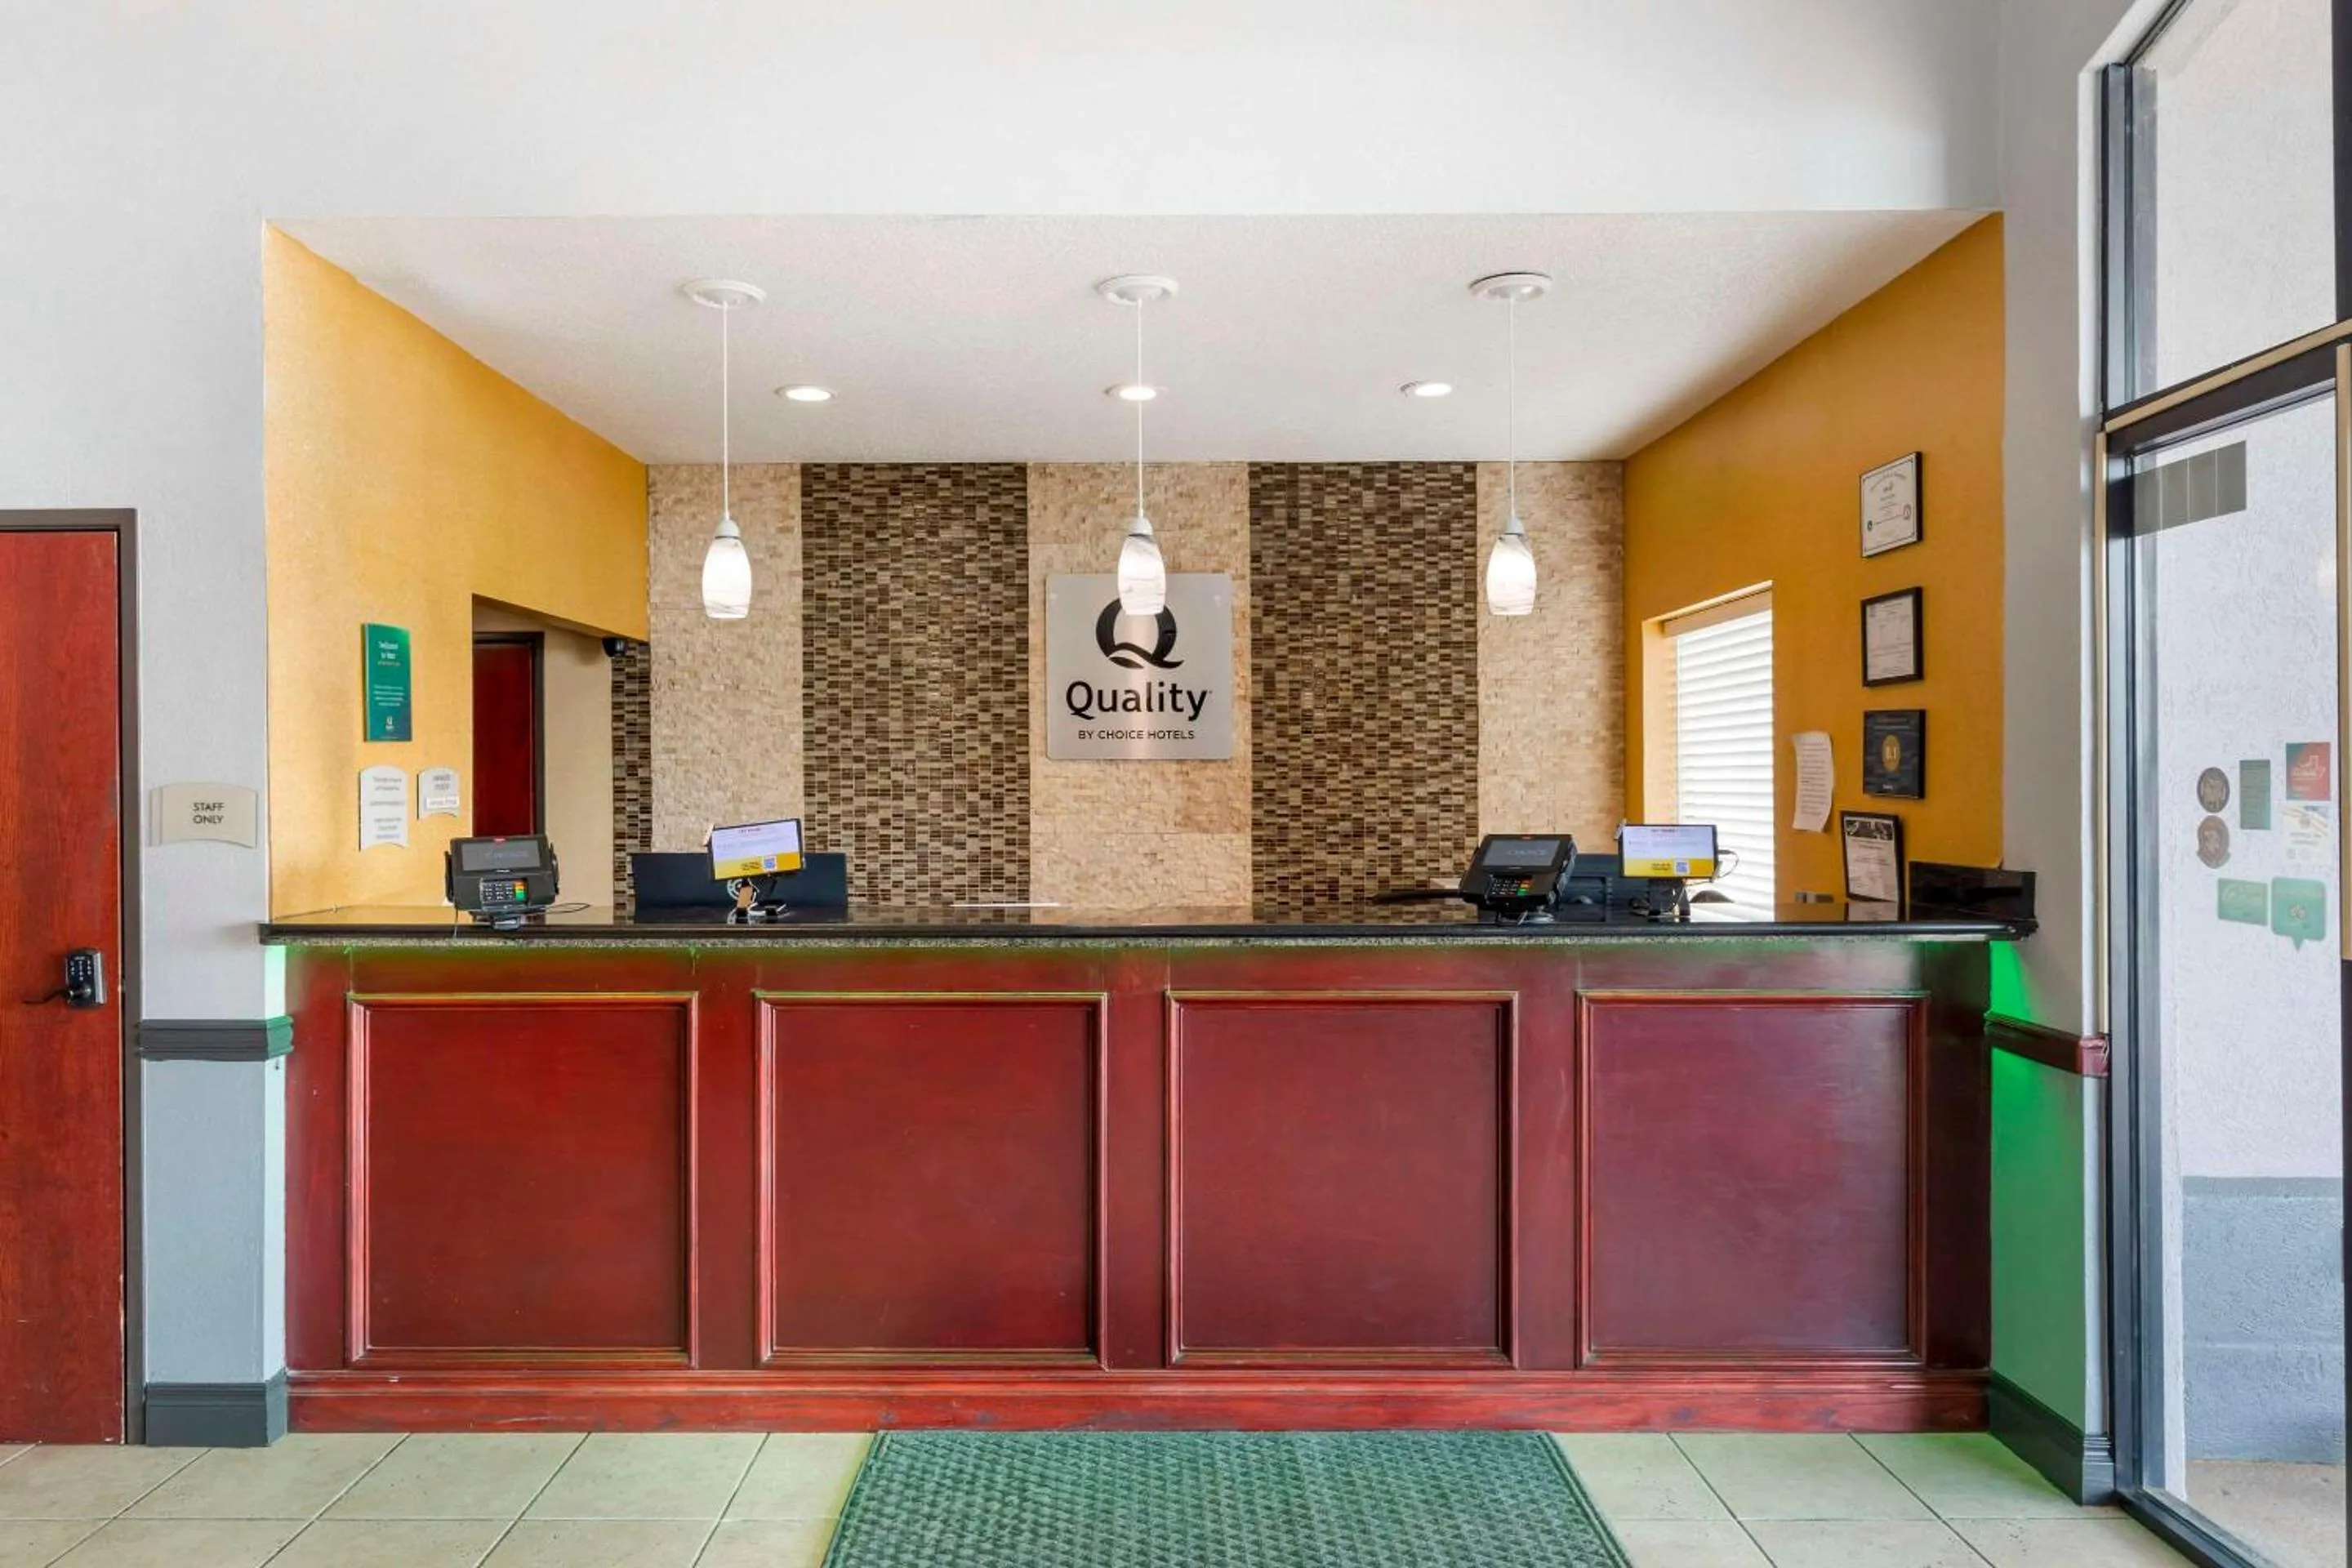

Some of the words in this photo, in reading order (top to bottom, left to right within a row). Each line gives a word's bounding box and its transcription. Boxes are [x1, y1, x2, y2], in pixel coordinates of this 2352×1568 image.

[1066, 680, 1208, 721] Quality
[1078, 730, 1094, 739] BY
[1097, 730, 1144, 739] CHOICE
[1147, 730, 1195, 739] HOTELS
[193, 802, 225, 812] STAFF
[193, 814, 225, 824] ONLY
